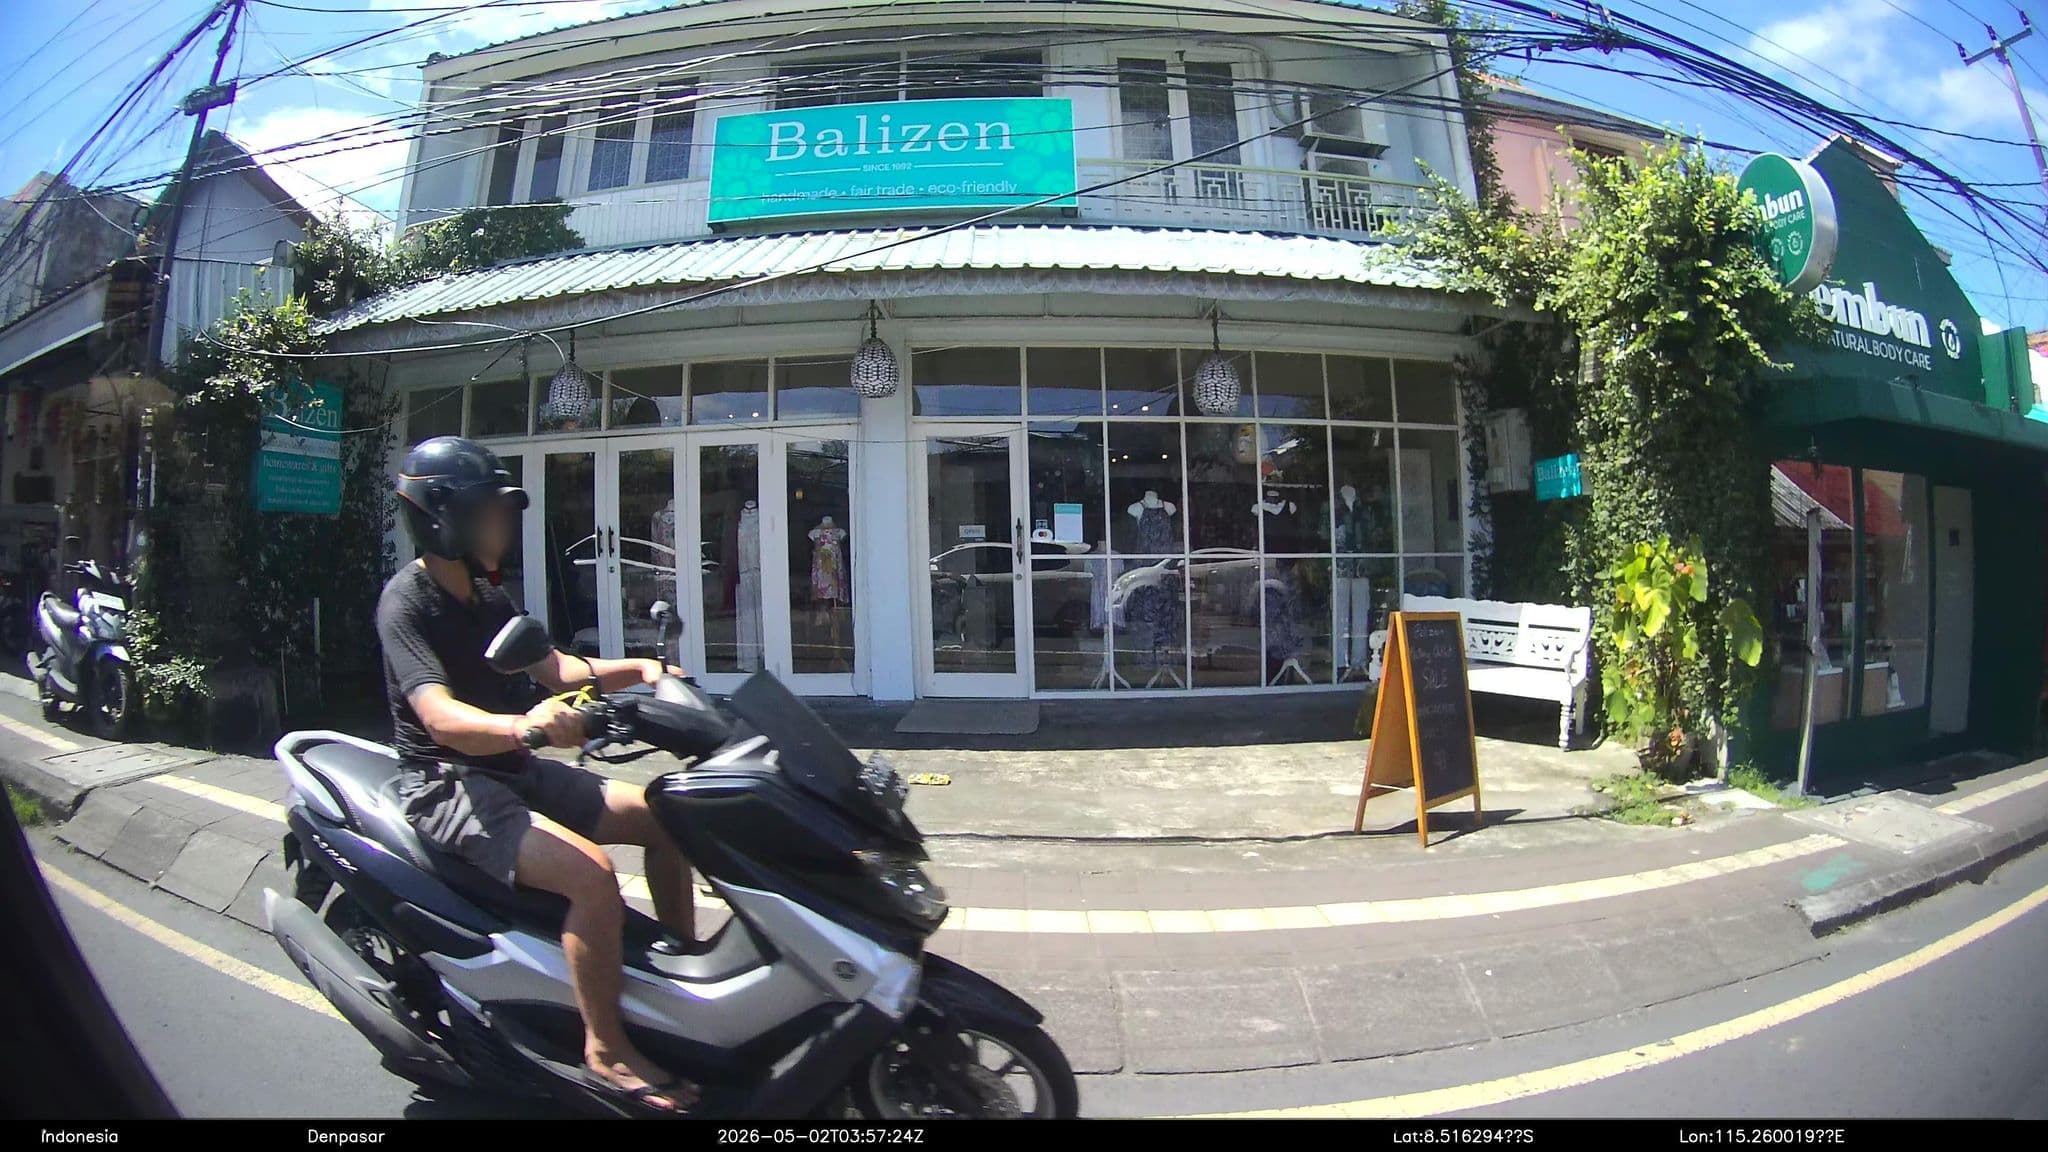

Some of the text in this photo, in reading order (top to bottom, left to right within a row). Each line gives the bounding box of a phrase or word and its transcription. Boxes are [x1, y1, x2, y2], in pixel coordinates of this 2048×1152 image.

[765, 114, 1015, 162] Balizen
[863, 163, 890, 173] SINCE
[850, 184, 873, 197] fair
[876, 183, 915, 197] trade
[928, 180, 1017, 195] eco-friendly
[1809, 282, 1931, 348] embun
[1872, 339, 1902, 363] BODY
[1904, 347, 1932, 371] CARE
